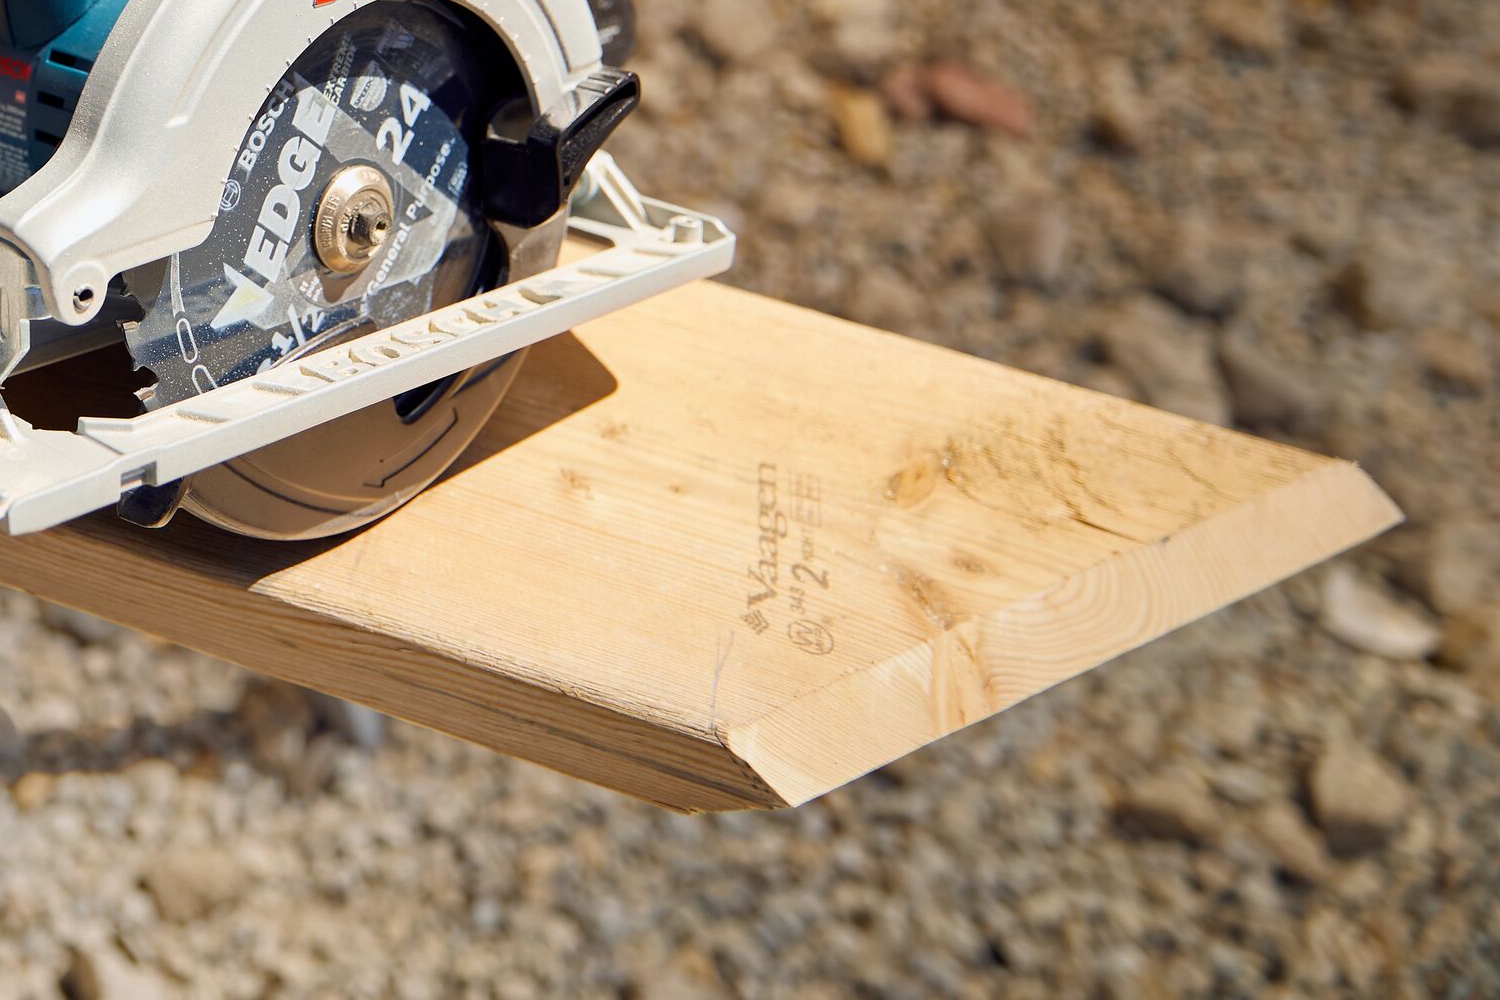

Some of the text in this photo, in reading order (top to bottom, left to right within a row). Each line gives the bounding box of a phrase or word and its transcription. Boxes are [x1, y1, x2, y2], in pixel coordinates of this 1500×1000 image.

[237, 77, 296, 172] BOSCH
[376, 81, 432, 166] 24
[244, 85, 339, 283] EDGE
[366, 221, 412, 297] General
[747, 462, 788, 609] Vaagen
[792, 563, 829, 590] 2
